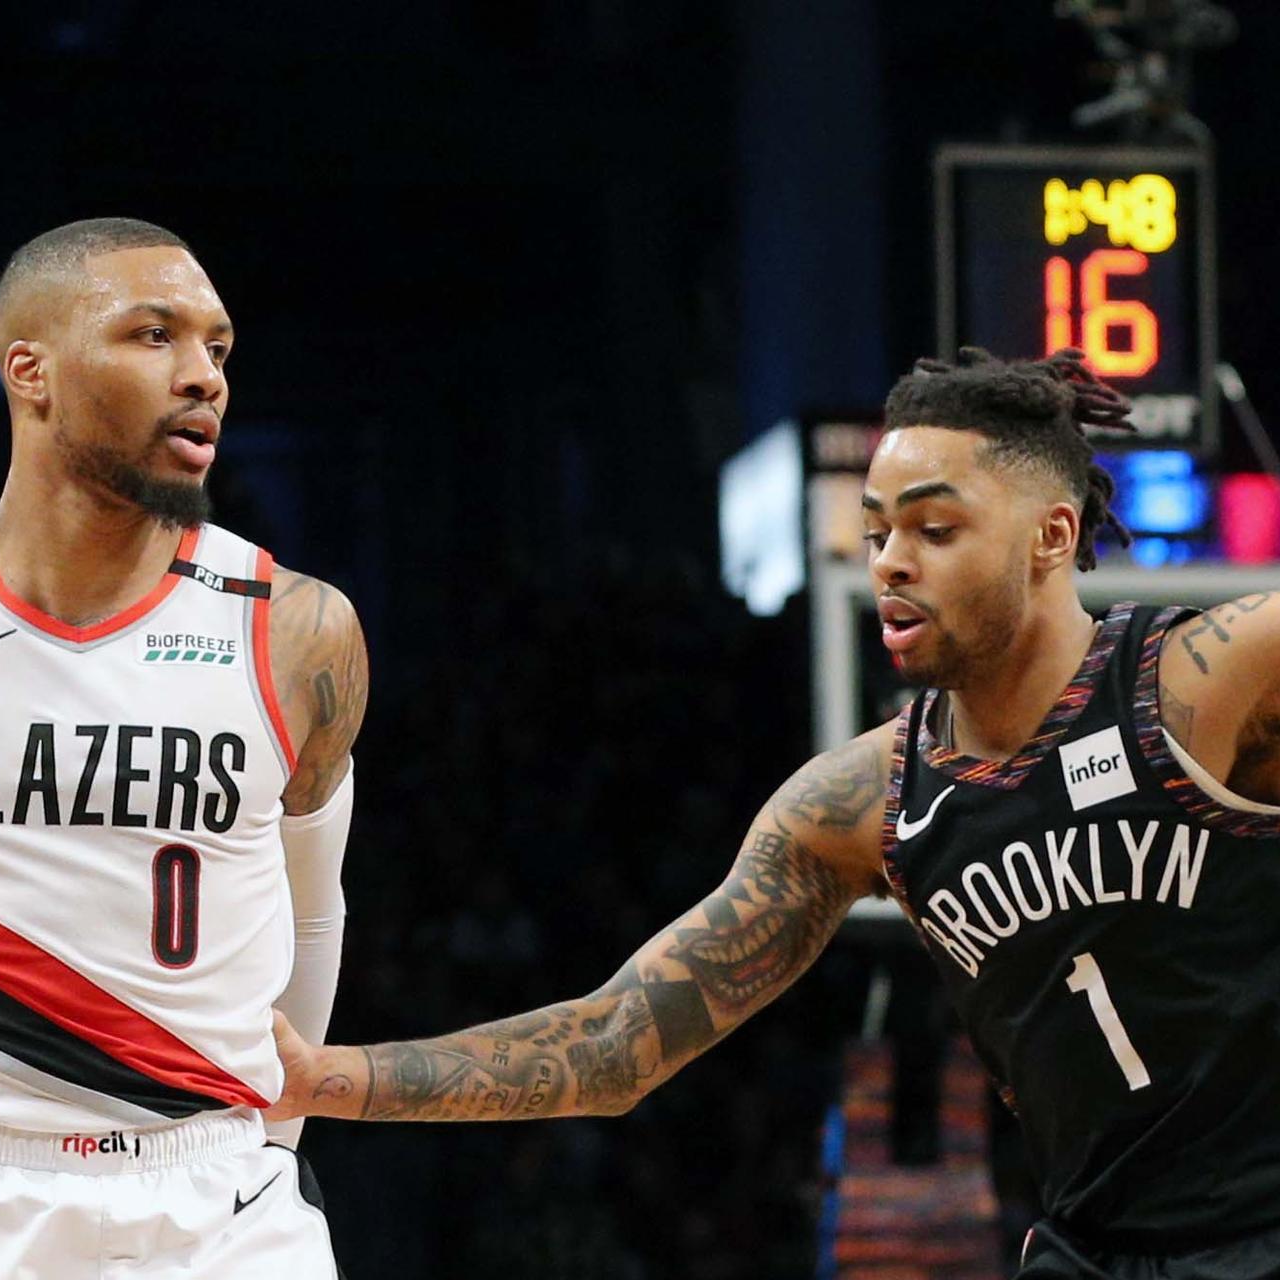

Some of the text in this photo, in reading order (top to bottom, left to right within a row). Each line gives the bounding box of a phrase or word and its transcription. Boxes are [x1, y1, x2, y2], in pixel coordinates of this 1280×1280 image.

[1045, 249, 1159, 377] 16
[194, 566, 224, 591] PGA
[1068, 753, 1121, 785] infor
[151, 843, 201, 970] 0
[920, 819, 1210, 979] BROOKLYN
[1065, 951, 1151, 1092] 1
